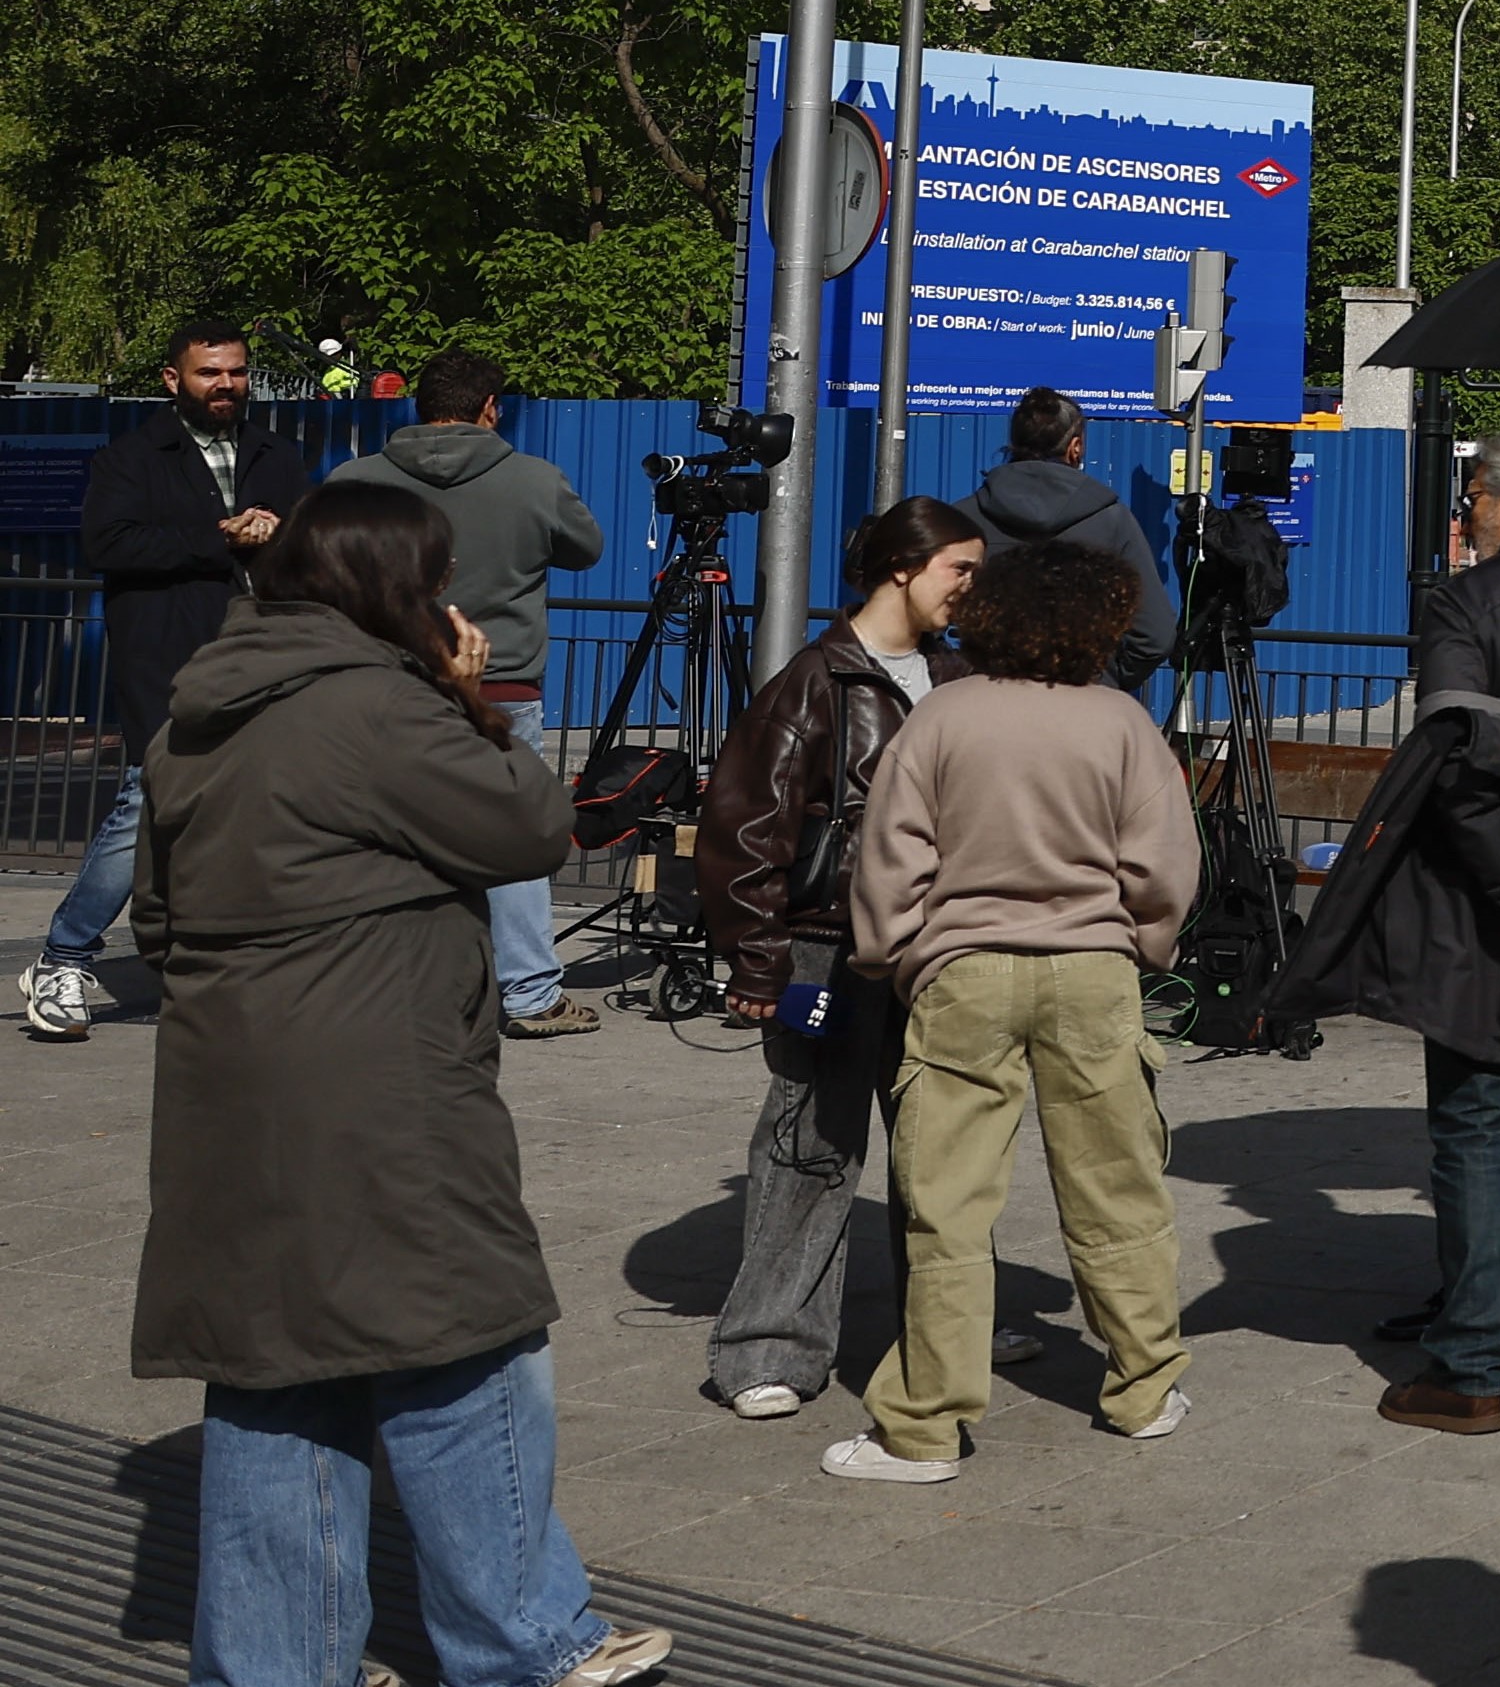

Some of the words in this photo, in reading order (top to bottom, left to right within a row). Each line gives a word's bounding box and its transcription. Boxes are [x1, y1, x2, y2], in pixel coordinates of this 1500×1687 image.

[1042, 154, 1071, 174] DE
[1076, 157, 1220, 185] ASCENSORES
[1254, 171, 1282, 185] Metro
[918, 179, 1031, 206] ESTACIÓN
[1037, 187, 1067, 208] DE
[1072, 190, 1231, 219] CARABANCHEL
[913, 229, 1006, 252] installation
[1010, 239, 1026, 254] at
[1031, 237, 1138, 260] Carabanchel
[1075, 293, 1163, 312] 3.325.814,56
[1166, 298, 1175, 311] €
[917, 314, 938, 328] DE
[942, 316, 992, 331] OBRA:
[1000, 319, 1023, 333] Start
[1026, 321, 1037, 333] of
[1039, 321, 1066, 334] work:
[1071, 319, 1115, 341] junio
[1124, 325, 1155, 340] June
[826, 379, 880, 393] Trabajamo
[912, 382, 957, 395] ofrecerle
[959, 386, 973, 394] un
[974, 385, 1003, 398] mejor
[1111, 389, 1124, 399] las
[940, 398, 948, 406] to
[976, 400, 989, 409] you
